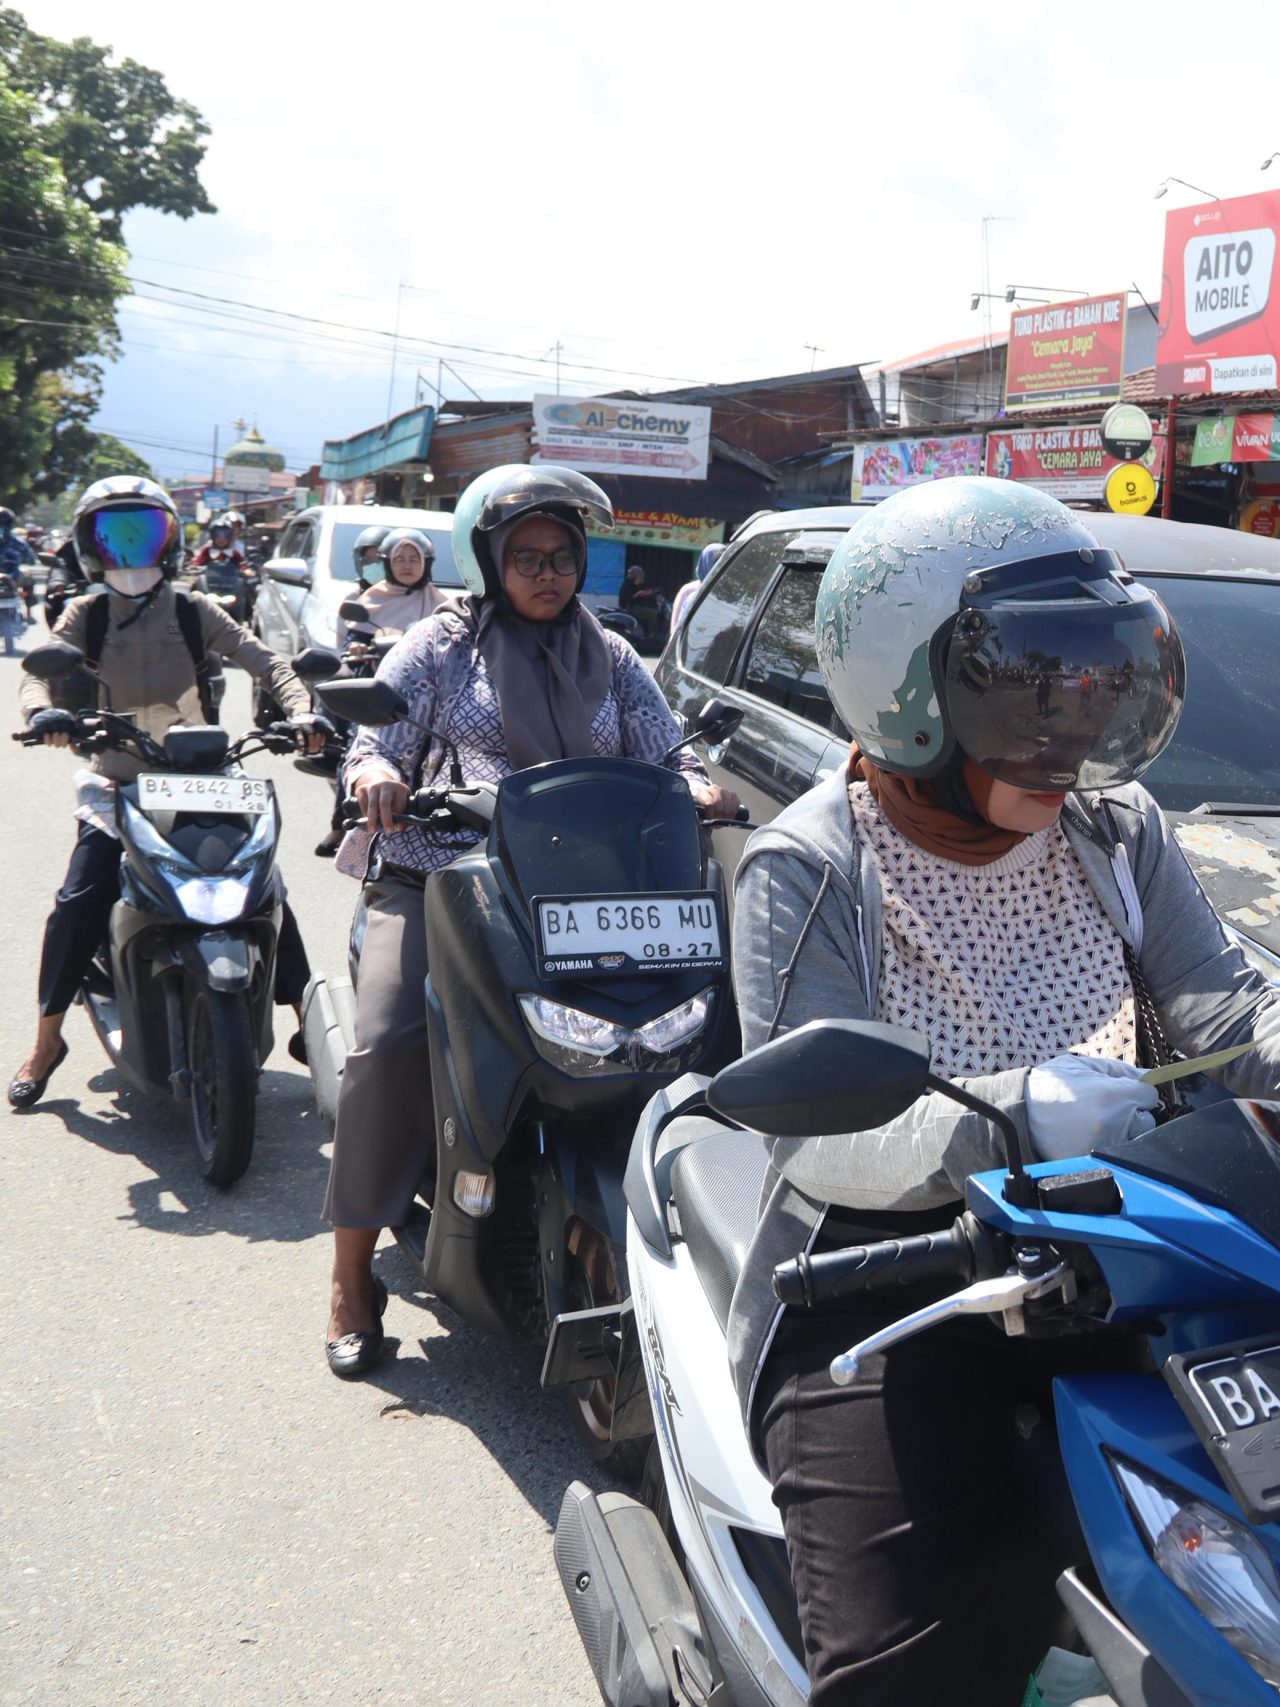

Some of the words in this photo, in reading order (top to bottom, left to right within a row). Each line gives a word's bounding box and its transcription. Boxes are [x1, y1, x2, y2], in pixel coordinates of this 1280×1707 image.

[1196, 240, 1253, 282] AITO
[1195, 285, 1249, 313] MOBILE
[1014, 315, 1033, 337] TOKO
[1034, 309, 1065, 334] PLASTIK
[1074, 303, 1102, 327] BAHAN
[1103, 300, 1120, 323] KUE
[1214, 367, 1249, 380] Dapatkan
[1250, 365, 1258, 377] di
[1259, 364, 1273, 376] sini
[586, 410, 691, 436] Al-Chemy
[1012, 434, 1032, 450] TOKO
[1035, 431, 1071, 450] PLASTIK
[1073, 431, 1080, 448] &
[1119, 495, 1148, 506] baseus
[146, 778, 170, 793] BA
[183, 779, 229, 794] 2842
[546, 910, 579, 935] BA
[596, 905, 661, 931] 6366
[678, 905, 713, 929] MU
[555, 959, 594, 971] YAMAHA
